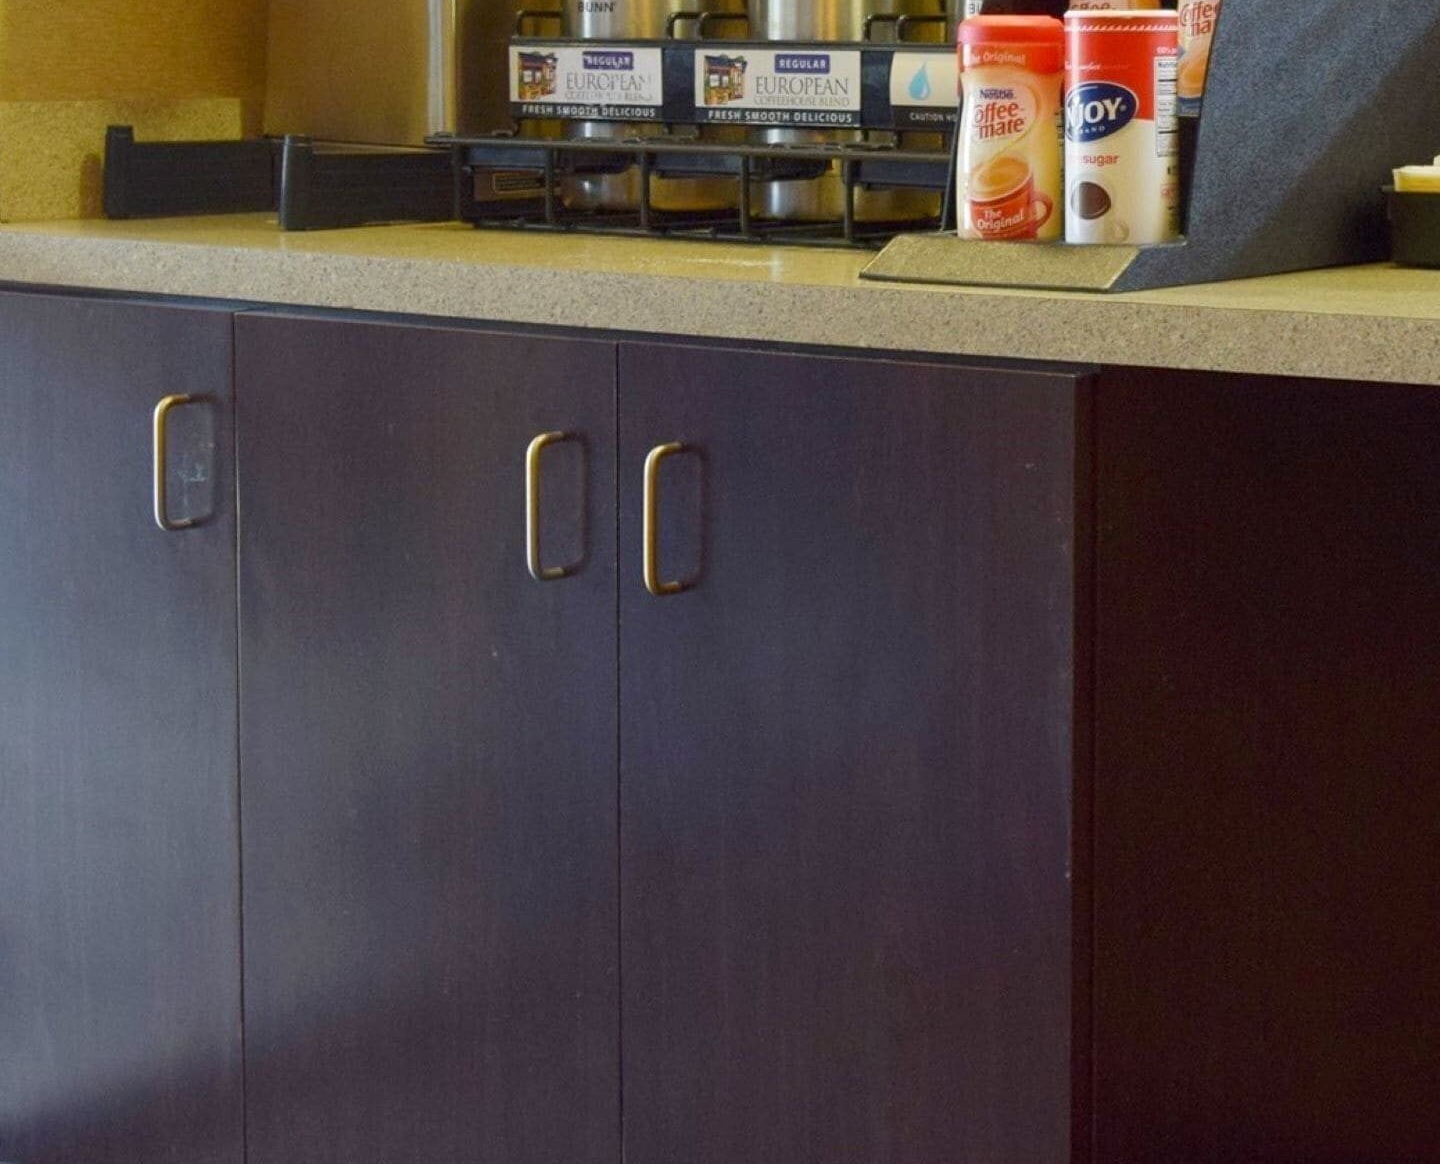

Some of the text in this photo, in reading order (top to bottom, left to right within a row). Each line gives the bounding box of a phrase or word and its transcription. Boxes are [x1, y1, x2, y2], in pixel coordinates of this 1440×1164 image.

[577, 1, 614, 13] BUNN
[587, 55, 631, 67] REGULAR
[778, 58, 827, 70] REGULAR
[755, 76, 849, 96] EUROPEAN
[754, 96, 850, 108] COFFEEHOUSE BLEND
[522, 104, 656, 118] FRESH SMOOTH DELICIOUS
[708, 109, 852, 124] FRESH SMOOTH DELICIOUS
[1082, 154, 1120, 167] sugar
[977, 208, 1025, 230] Original
[983, 208, 1003, 220] The
